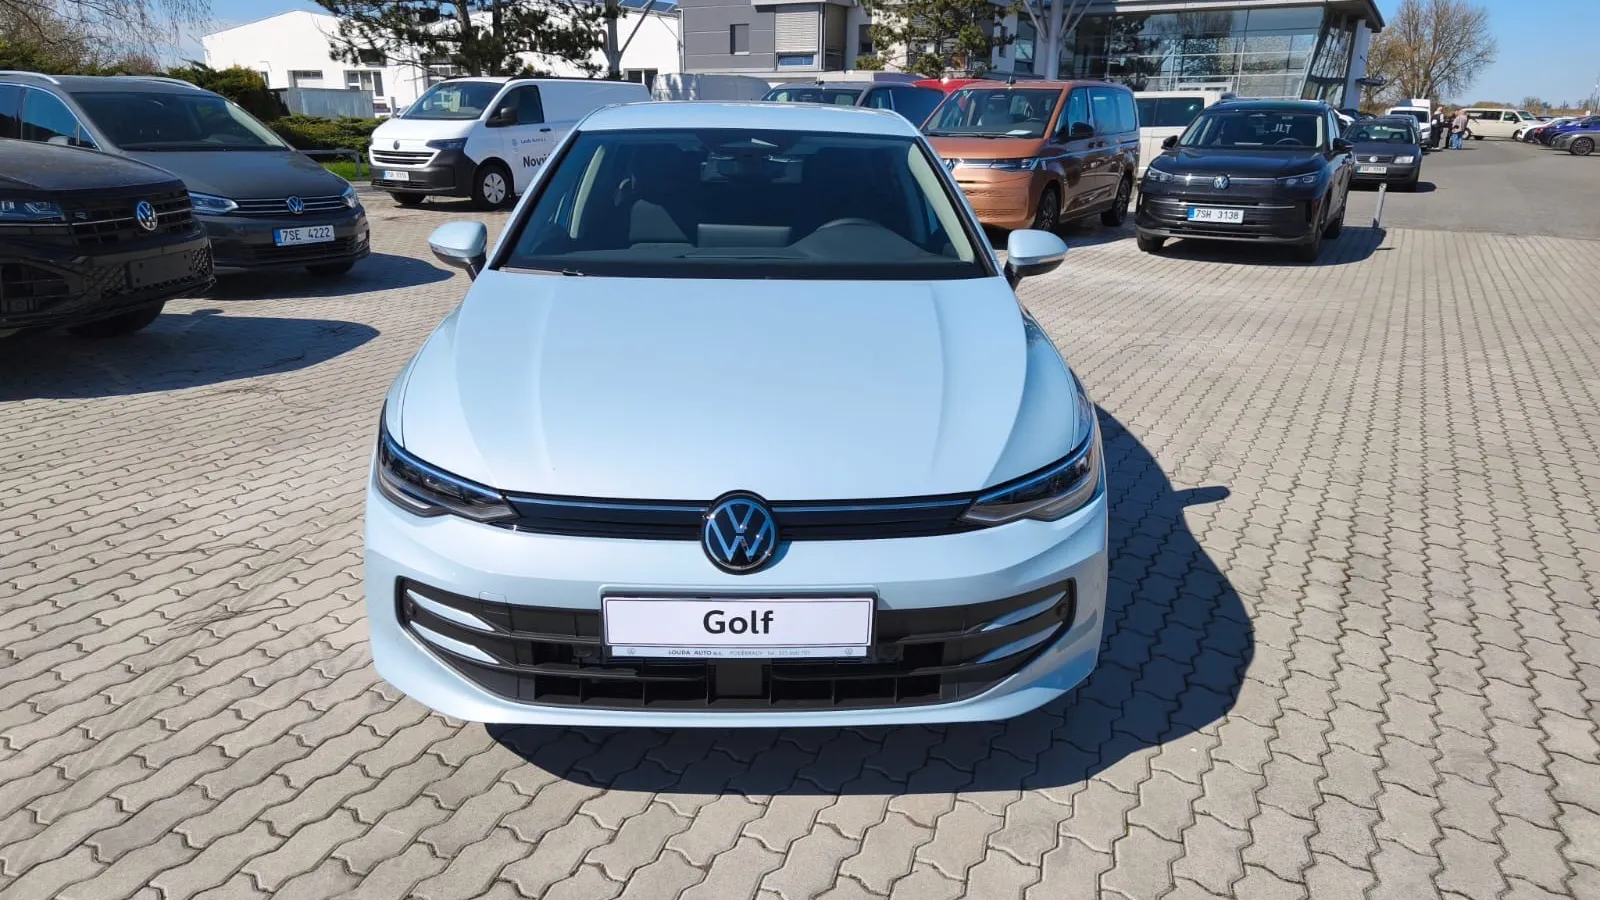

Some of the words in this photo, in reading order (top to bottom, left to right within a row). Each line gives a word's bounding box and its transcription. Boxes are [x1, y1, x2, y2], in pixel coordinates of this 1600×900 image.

[1195, 209, 1212, 219] 7SH
[1217, 210, 1239, 220] 3138
[282, 229, 302, 241] 7SE
[307, 227, 331, 239] 4222
[703, 609, 774, 634] Golf
